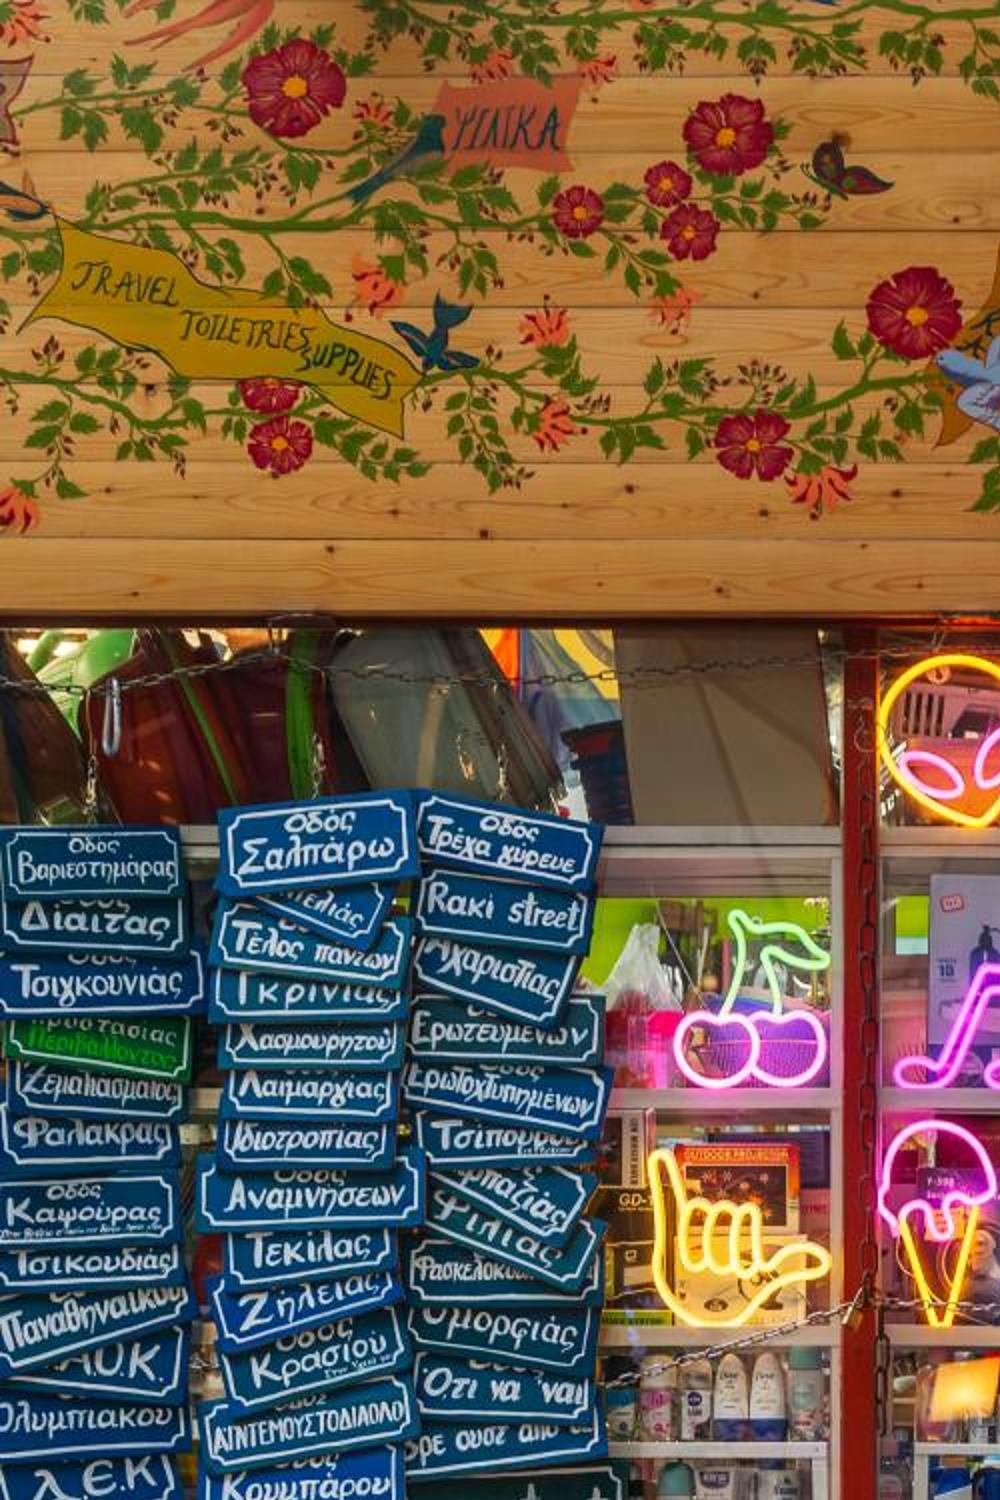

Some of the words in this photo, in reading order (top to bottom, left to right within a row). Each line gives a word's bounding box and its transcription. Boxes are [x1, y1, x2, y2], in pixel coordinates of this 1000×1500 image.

[71, 261, 180, 306] TRAVEL
[180, 309, 314, 355] TOILETRIES
[302, 343, 396, 402] SUPPLIES
[238, 835, 394, 875] Σαλπάρω
[427, 881, 494, 919] Raki
[508, 892, 581, 931] street
[10, 963, 183, 1008] Τσιγκουνιάς
[6, 1197, 162, 1229] Καψούρας
